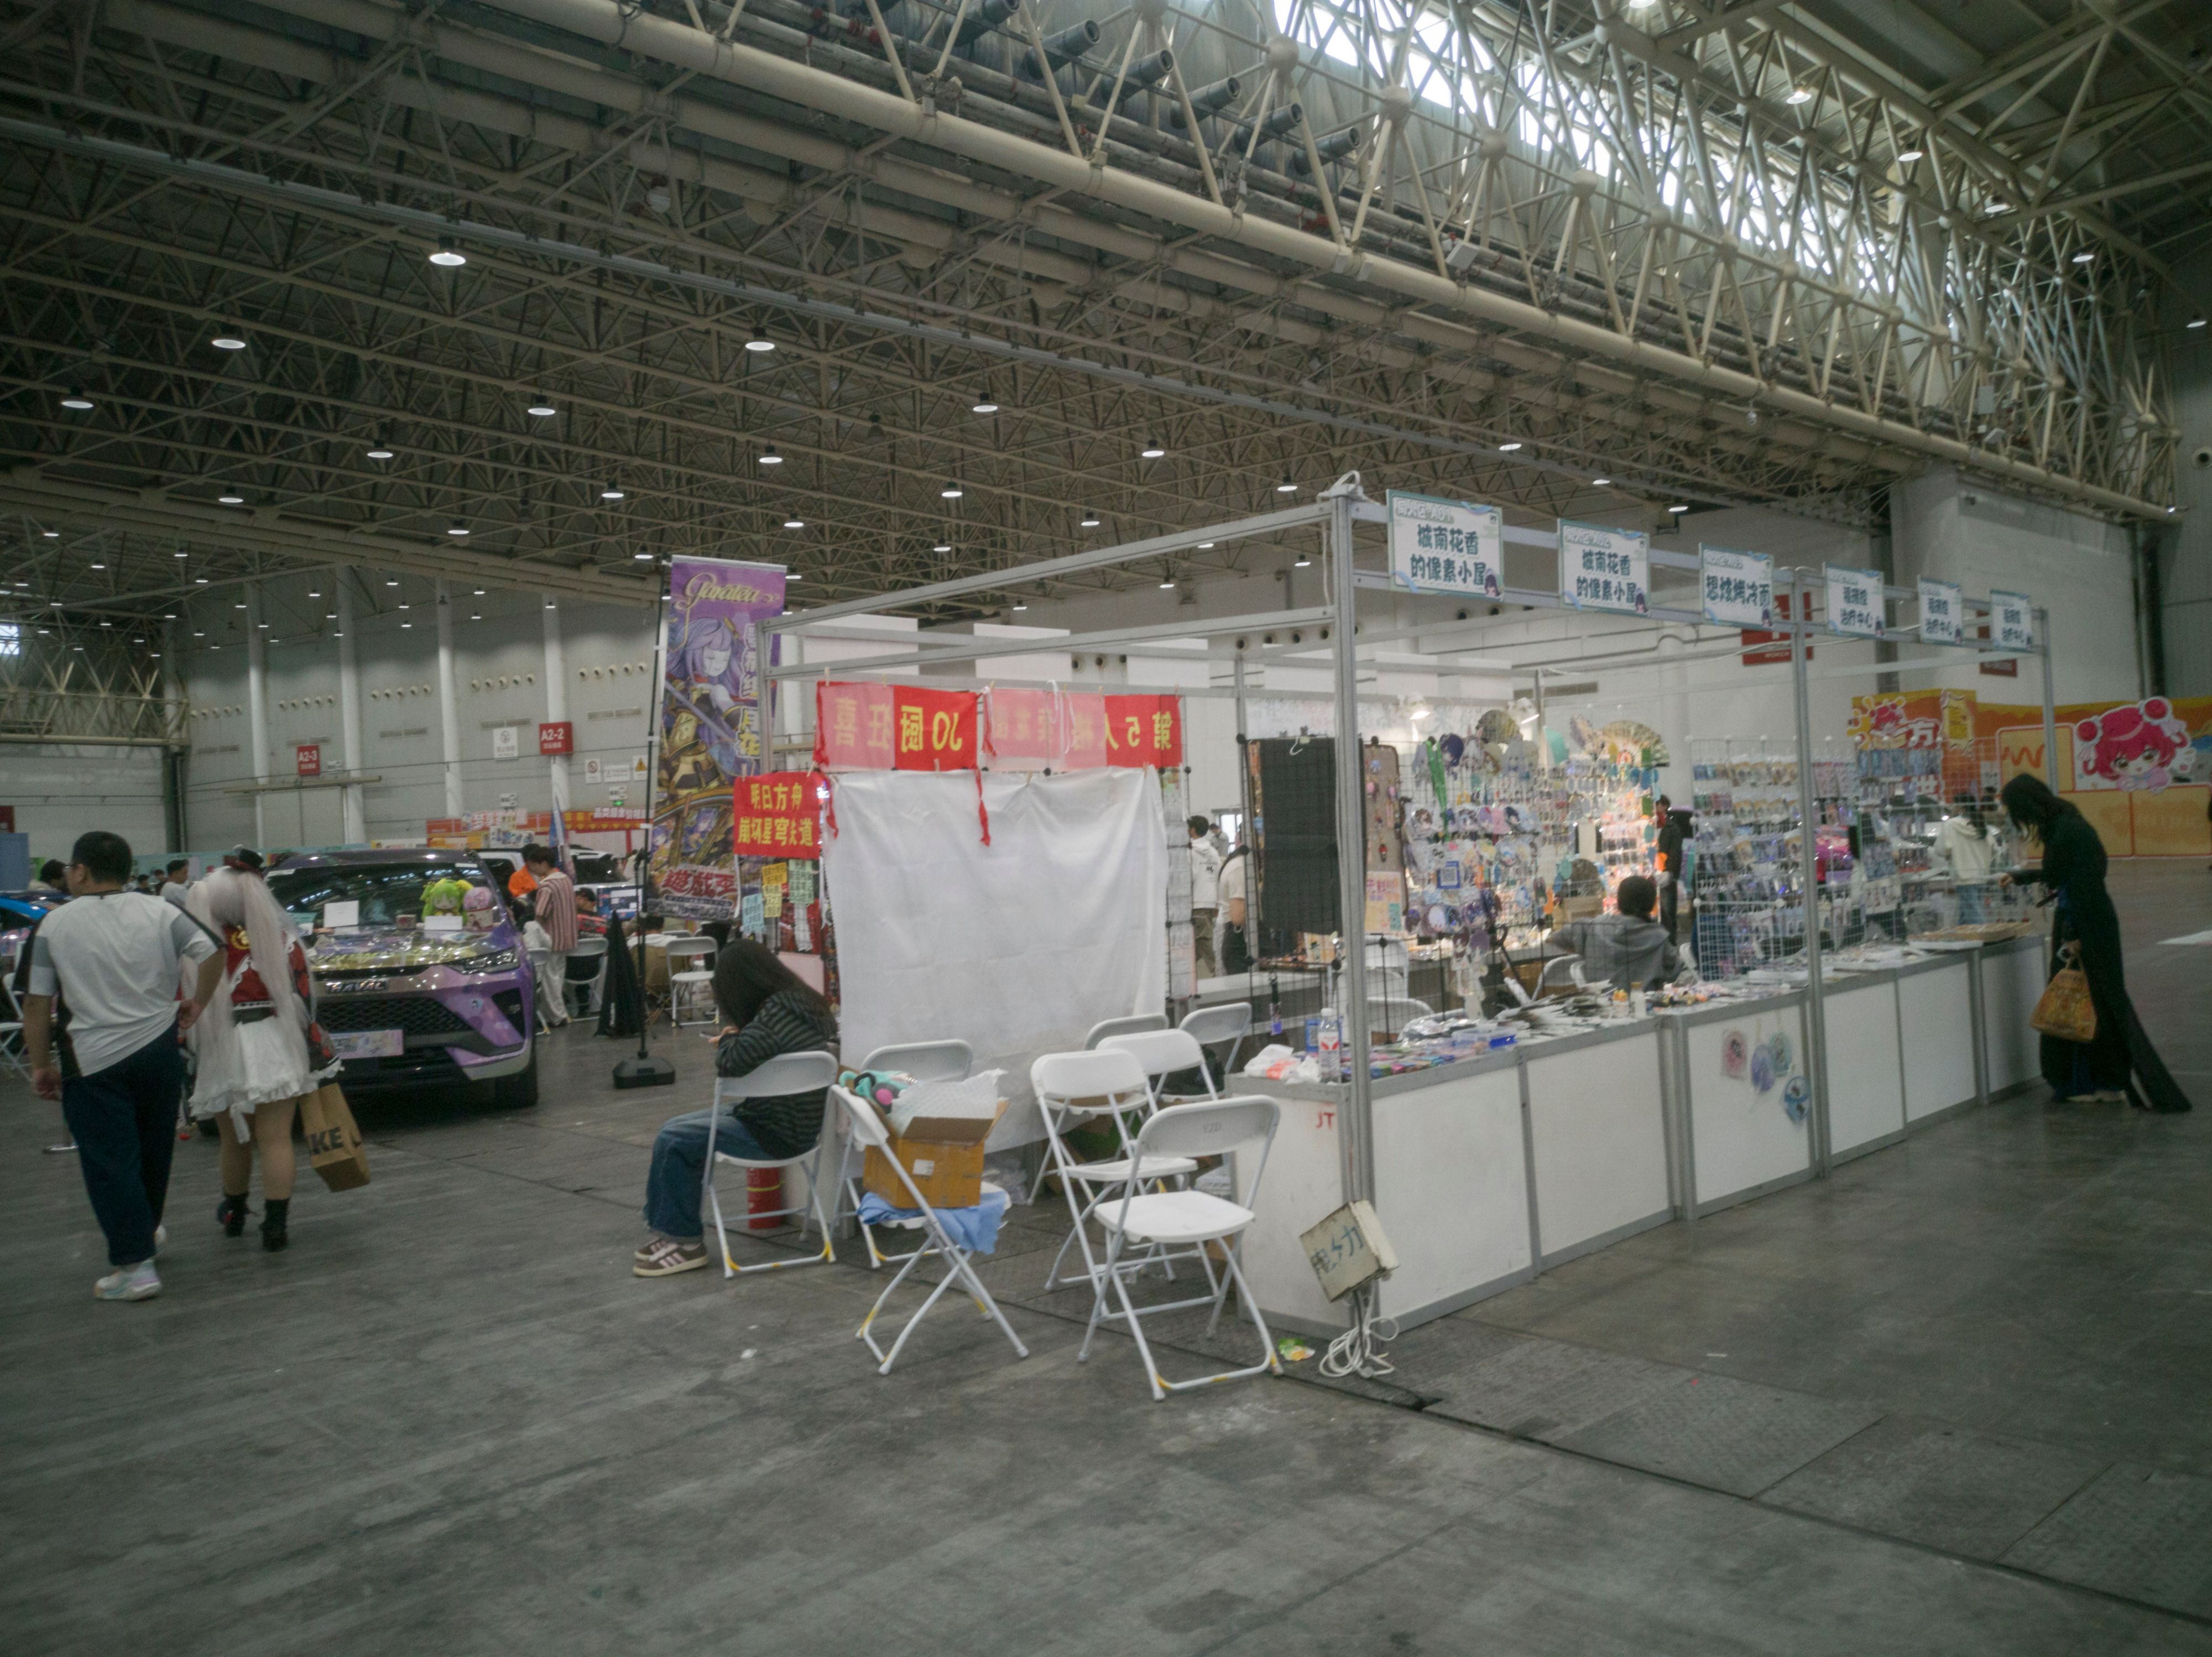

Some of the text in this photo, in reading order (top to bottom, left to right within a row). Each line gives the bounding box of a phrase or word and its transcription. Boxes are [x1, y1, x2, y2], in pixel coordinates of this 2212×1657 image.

[1410, 553, 1486, 586] 的像素小屋
[541, 728, 565, 741] A2-2
[299, 750, 318, 762] A2-3
[750, 782, 802, 812] 明日方舟
[331, 981, 384, 992] HAVAL
